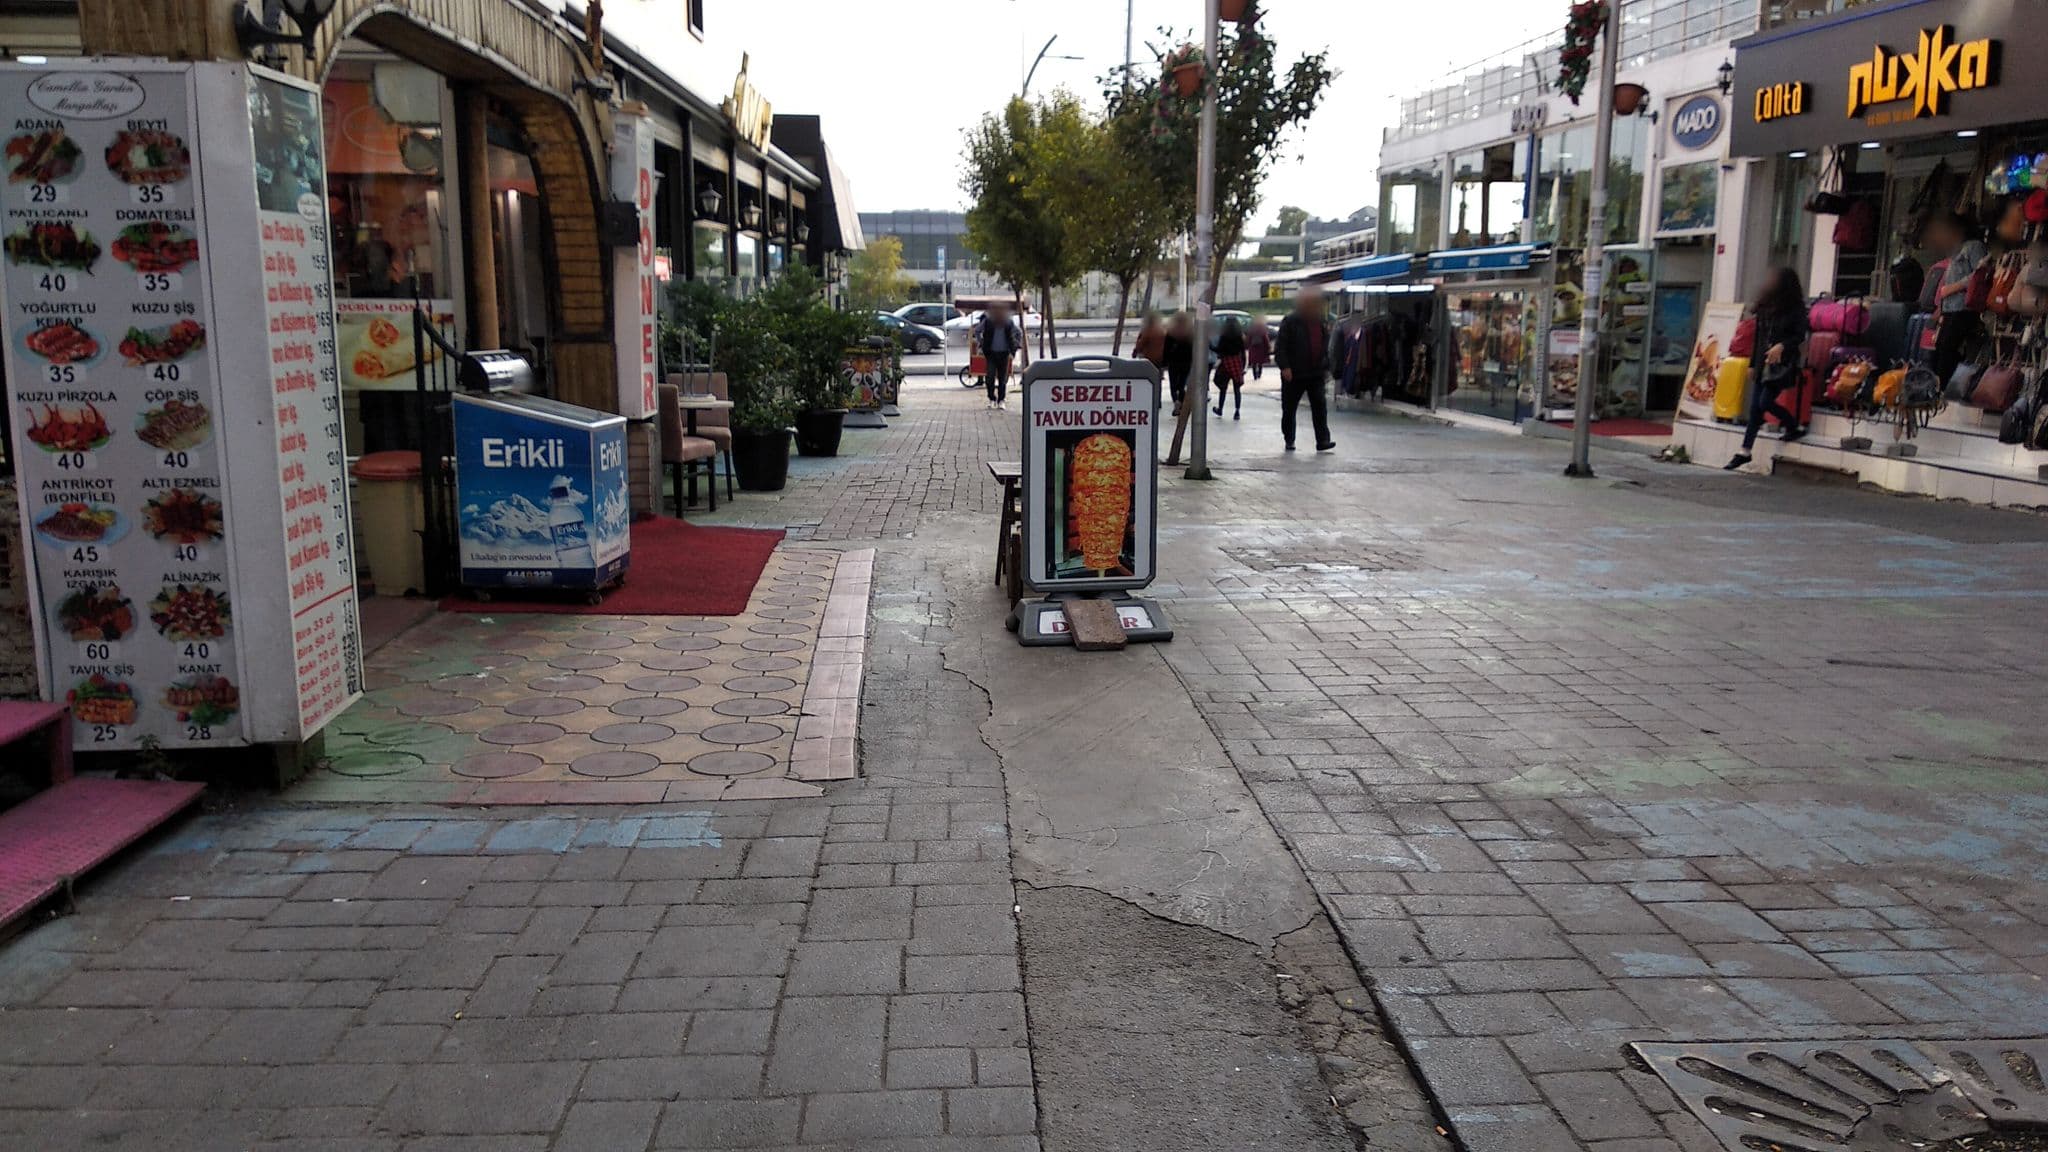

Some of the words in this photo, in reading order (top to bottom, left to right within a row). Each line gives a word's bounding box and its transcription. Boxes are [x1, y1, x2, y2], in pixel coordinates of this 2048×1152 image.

[15, 119, 65, 130] ADANA
[127, 118, 168, 131] BEYTİ
[1676, 104, 1716, 136] MADO
[31, 185, 56, 203] 29
[139, 185, 164, 203] 35
[9, 209, 89, 219] PATLICANLI
[116, 208, 196, 222] DOMATESLİ
[40, 275, 65, 291] 40
[145, 275, 169, 291] 35
[21, 302, 96, 314] YOĞURTLU
[132, 303, 169, 313] KUZU
[175, 302, 195, 315] ŞİŞ
[50, 366, 75, 382] 35
[154, 365, 179, 381] 40
[18, 392, 54, 401] KUZU
[58, 390, 117, 401] PİRZOLA
[145, 389, 174, 402] ÇÖP
[178, 390, 199, 402] ŞİŞ
[1051, 381, 1132, 403] SEBZELİ
[1034, 411, 1085, 427] TAVUK
[1090, 407, 1149, 427] DÖNER
[164, 452, 188, 468] 40
[482, 438, 564, 468] Erikli
[600, 440, 622, 471] Erikli
[58, 454, 84, 469] 40
[42, 476, 113, 489] ANTRİKOT
[143, 478, 170, 488] ALTI
[44, 490, 115, 504] (BONFİLE)
[73, 547, 98, 563] 45
[176, 546, 197, 561] 40
[64, 569, 117, 580] KARIŞIK
[162, 571, 221, 582] ALİNAZİK
[87, 644, 109, 660] 60
[184, 643, 209, 658] 40
[70, 665, 109, 675] TAVUK
[115, 663, 135, 676] ŞİŞ
[178, 664, 222, 674] KANAT
[94, 726, 117, 742] 25
[189, 727, 211, 741] 28
